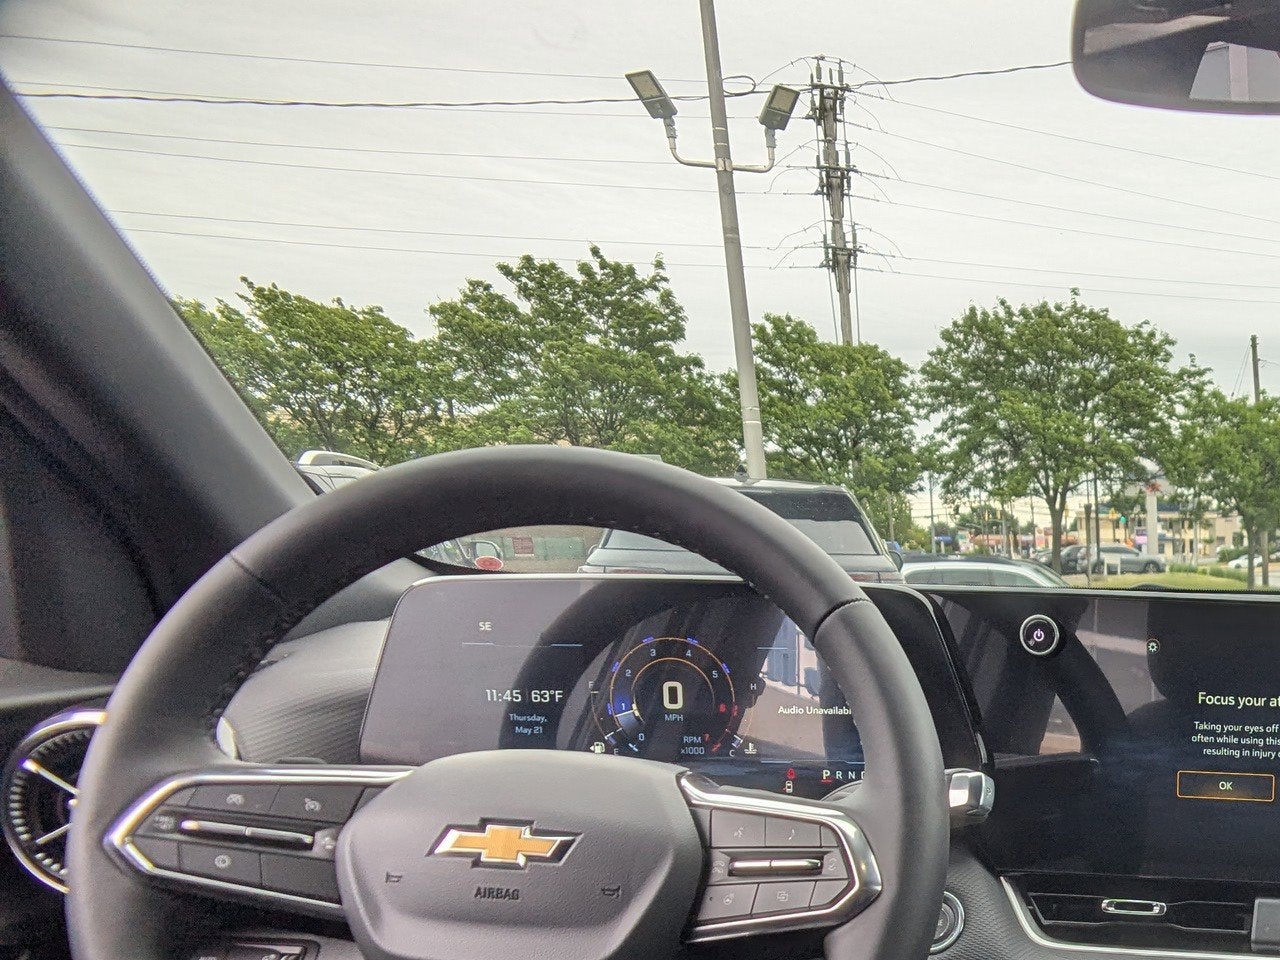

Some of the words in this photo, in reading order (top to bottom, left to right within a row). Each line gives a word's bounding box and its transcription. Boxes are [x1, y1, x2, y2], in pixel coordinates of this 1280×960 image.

[478, 621, 492, 631] SE
[650, 649, 657, 657] 3
[685, 649, 692, 657] 4
[625, 669, 632, 677] 2
[750, 683, 757, 691] H
[486, 689, 522, 702] 11:45
[532, 690, 564, 702] 63°F
[662, 681, 684, 710] 0
[1198, 691, 1235, 706] Focus
[1238, 696, 1267, 709] your
[620, 702, 627, 710] 1
[778, 705, 804, 715] Audio
[806, 705, 852, 715] Unavailabl
[509, 713, 548, 724] Thursday,
[664, 713, 684, 722] MPH
[515, 727, 532, 736] May
[534, 726, 543, 734] 21
[1194, 721, 1222, 733] Taking
[1223, 725, 1243, 733] your
[1244, 726, 1264, 734] eyes
[1266, 723, 1279, 733] off
[638, 733, 645, 741] 0
[683, 735, 702, 744] RPM
[1191, 733, 1215, 743] often
[1216, 734, 1239, 744] while
[1241, 736, 1264, 747] using
[681, 747, 705, 756] x1000
[729, 749, 735, 757] C
[1203, 747, 1240, 759] resulting
[1242, 748, 1250, 757] in
[1252, 748, 1276, 760] injury
[822, 769, 831, 780] P
[836, 770, 843, 780] R
[848, 771, 856, 780] N
[1219, 781, 1233, 791] OK
[473, 886, 520, 901] AIRBAG
